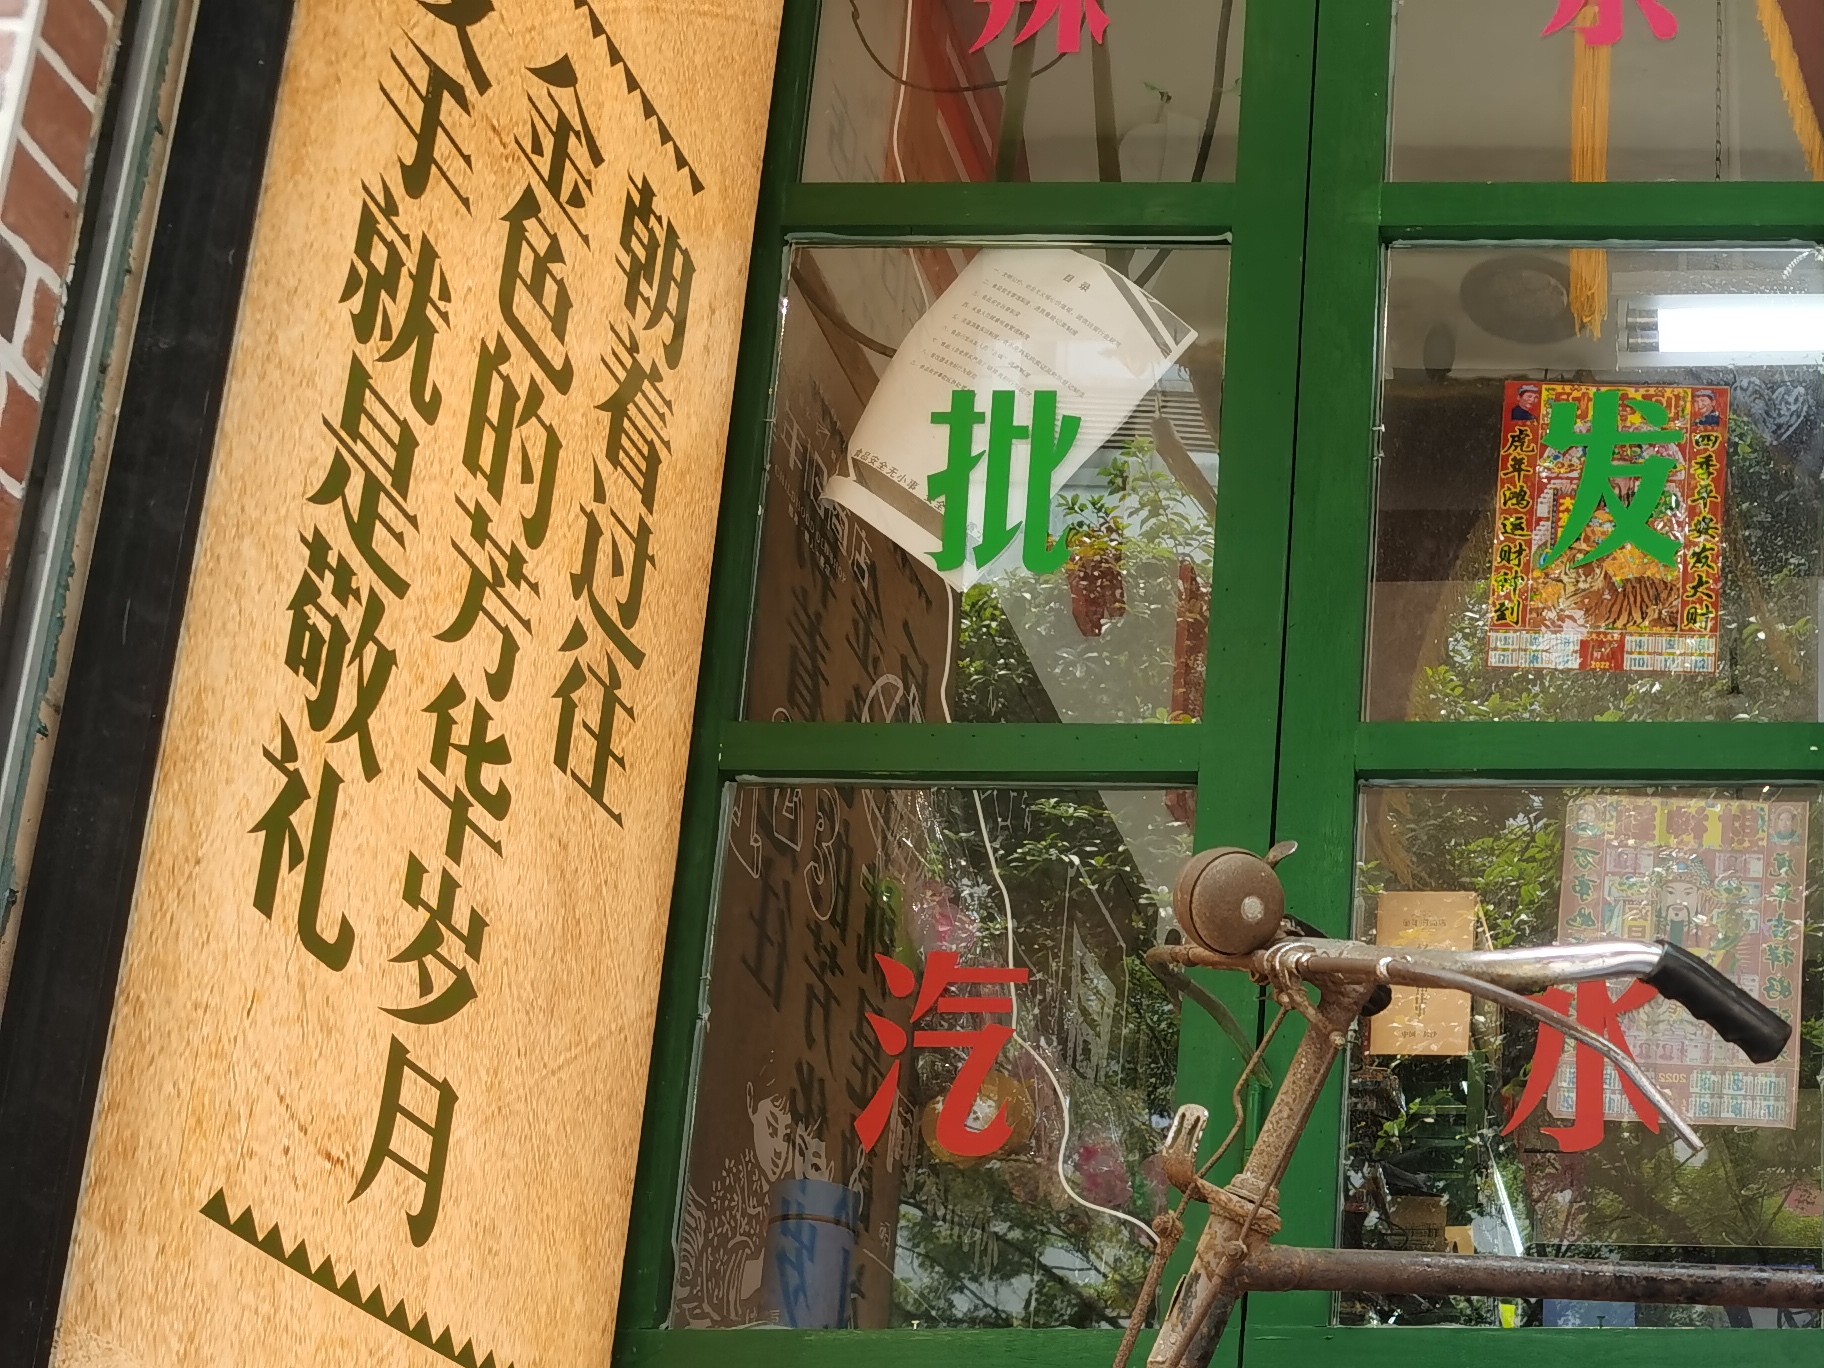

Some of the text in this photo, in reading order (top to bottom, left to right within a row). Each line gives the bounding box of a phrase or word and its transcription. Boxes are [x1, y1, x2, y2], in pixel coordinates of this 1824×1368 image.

[924, 390, 1082, 574] 批
[1537, 390, 1686, 571] 发
[1492, 427, 1536, 627] 虎年鸿运财神到
[1684, 431, 1722, 633] 四季平安发大财
[347, 52, 606, 1249] 金色的芳华岁月
[854, 951, 1030, 1157] 汽
